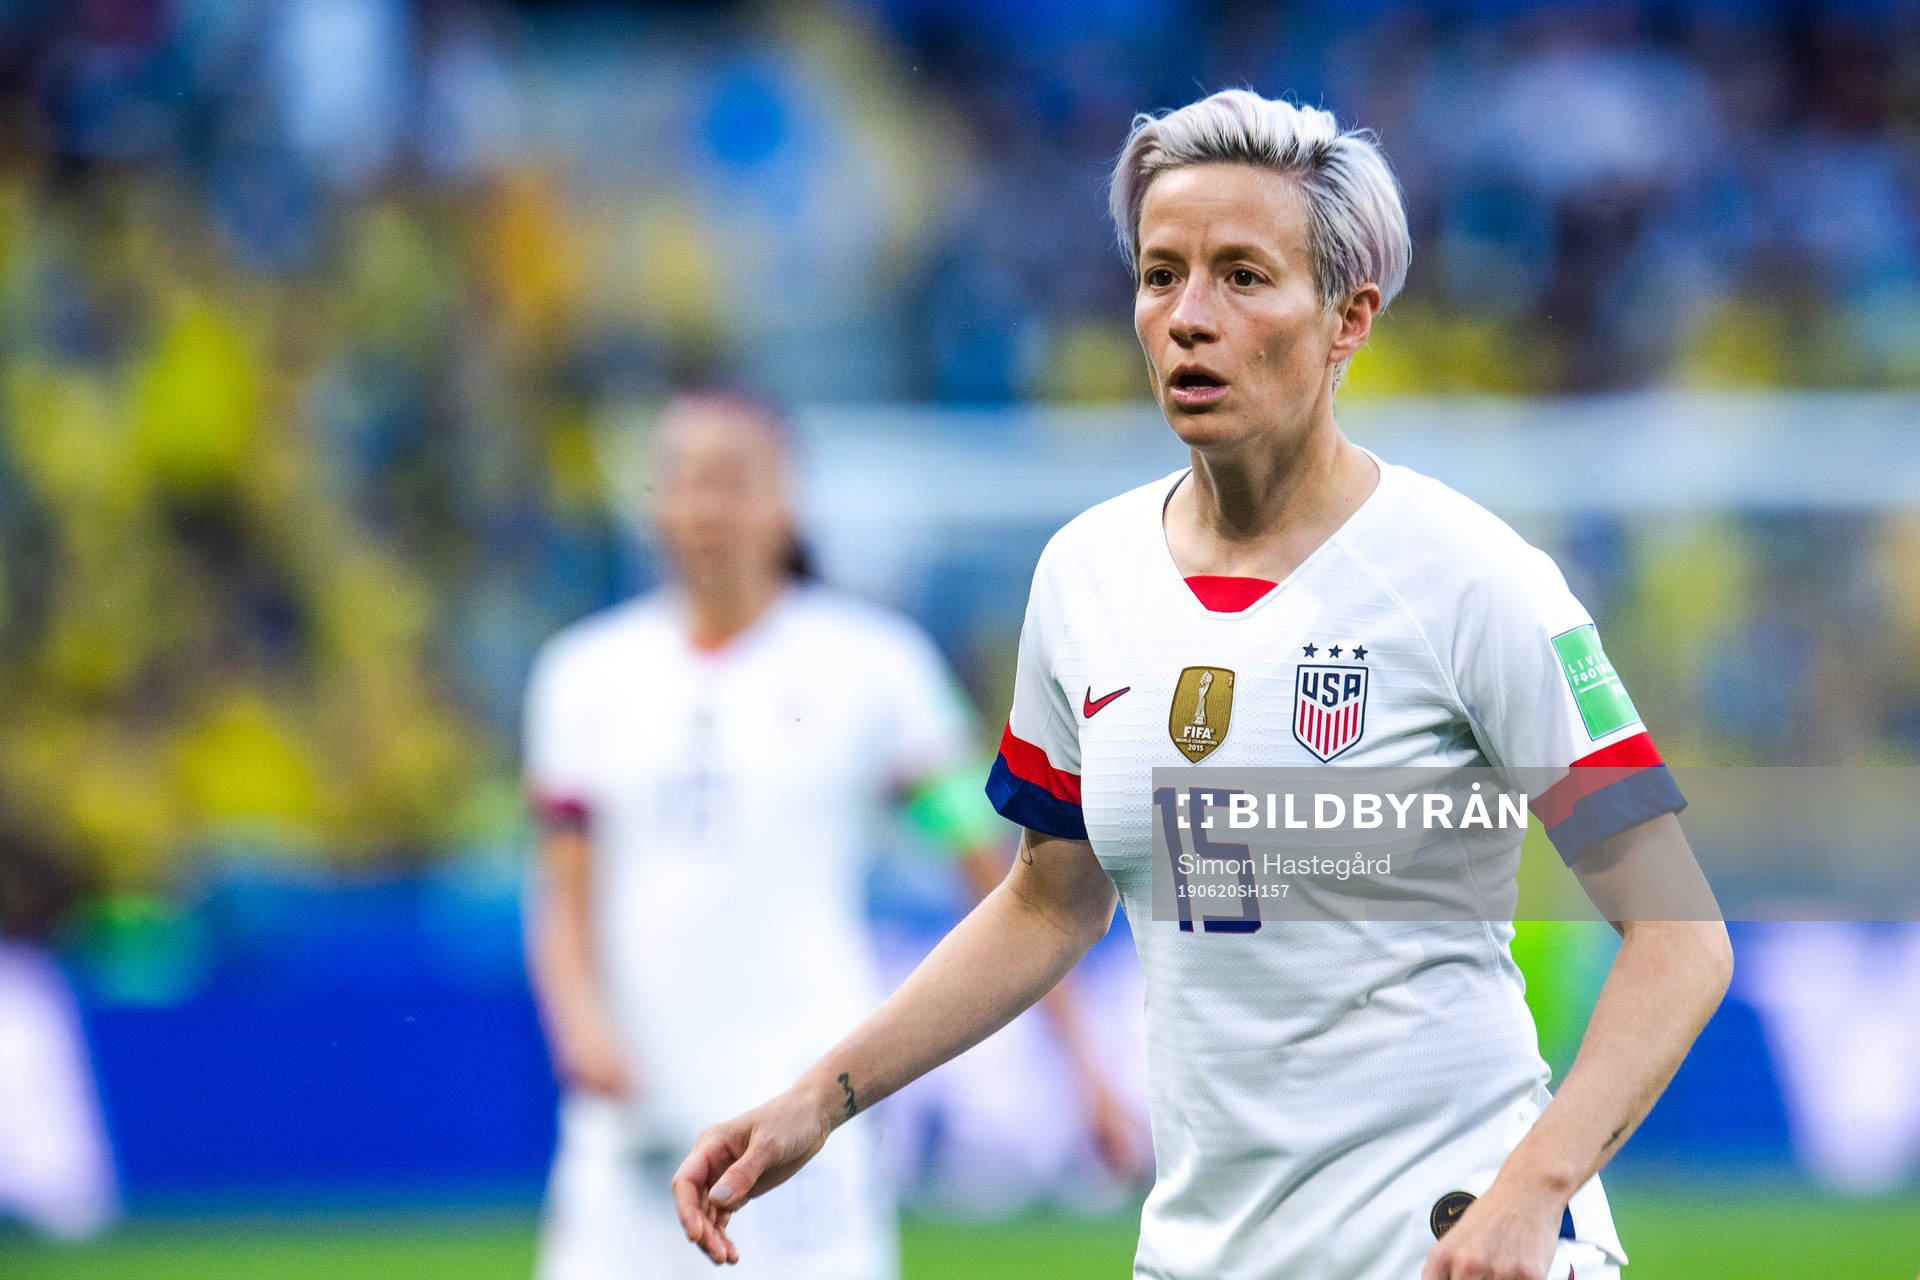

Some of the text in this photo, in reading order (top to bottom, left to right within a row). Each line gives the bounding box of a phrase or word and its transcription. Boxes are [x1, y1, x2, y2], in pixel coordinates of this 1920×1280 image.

[1567, 652, 1608, 674] LIVI
[1303, 672, 1361, 707] USA
[1183, 725, 1212, 739] FIFA
[1187, 744, 1204, 752] 2015
[1153, 787, 1262, 934] 15
